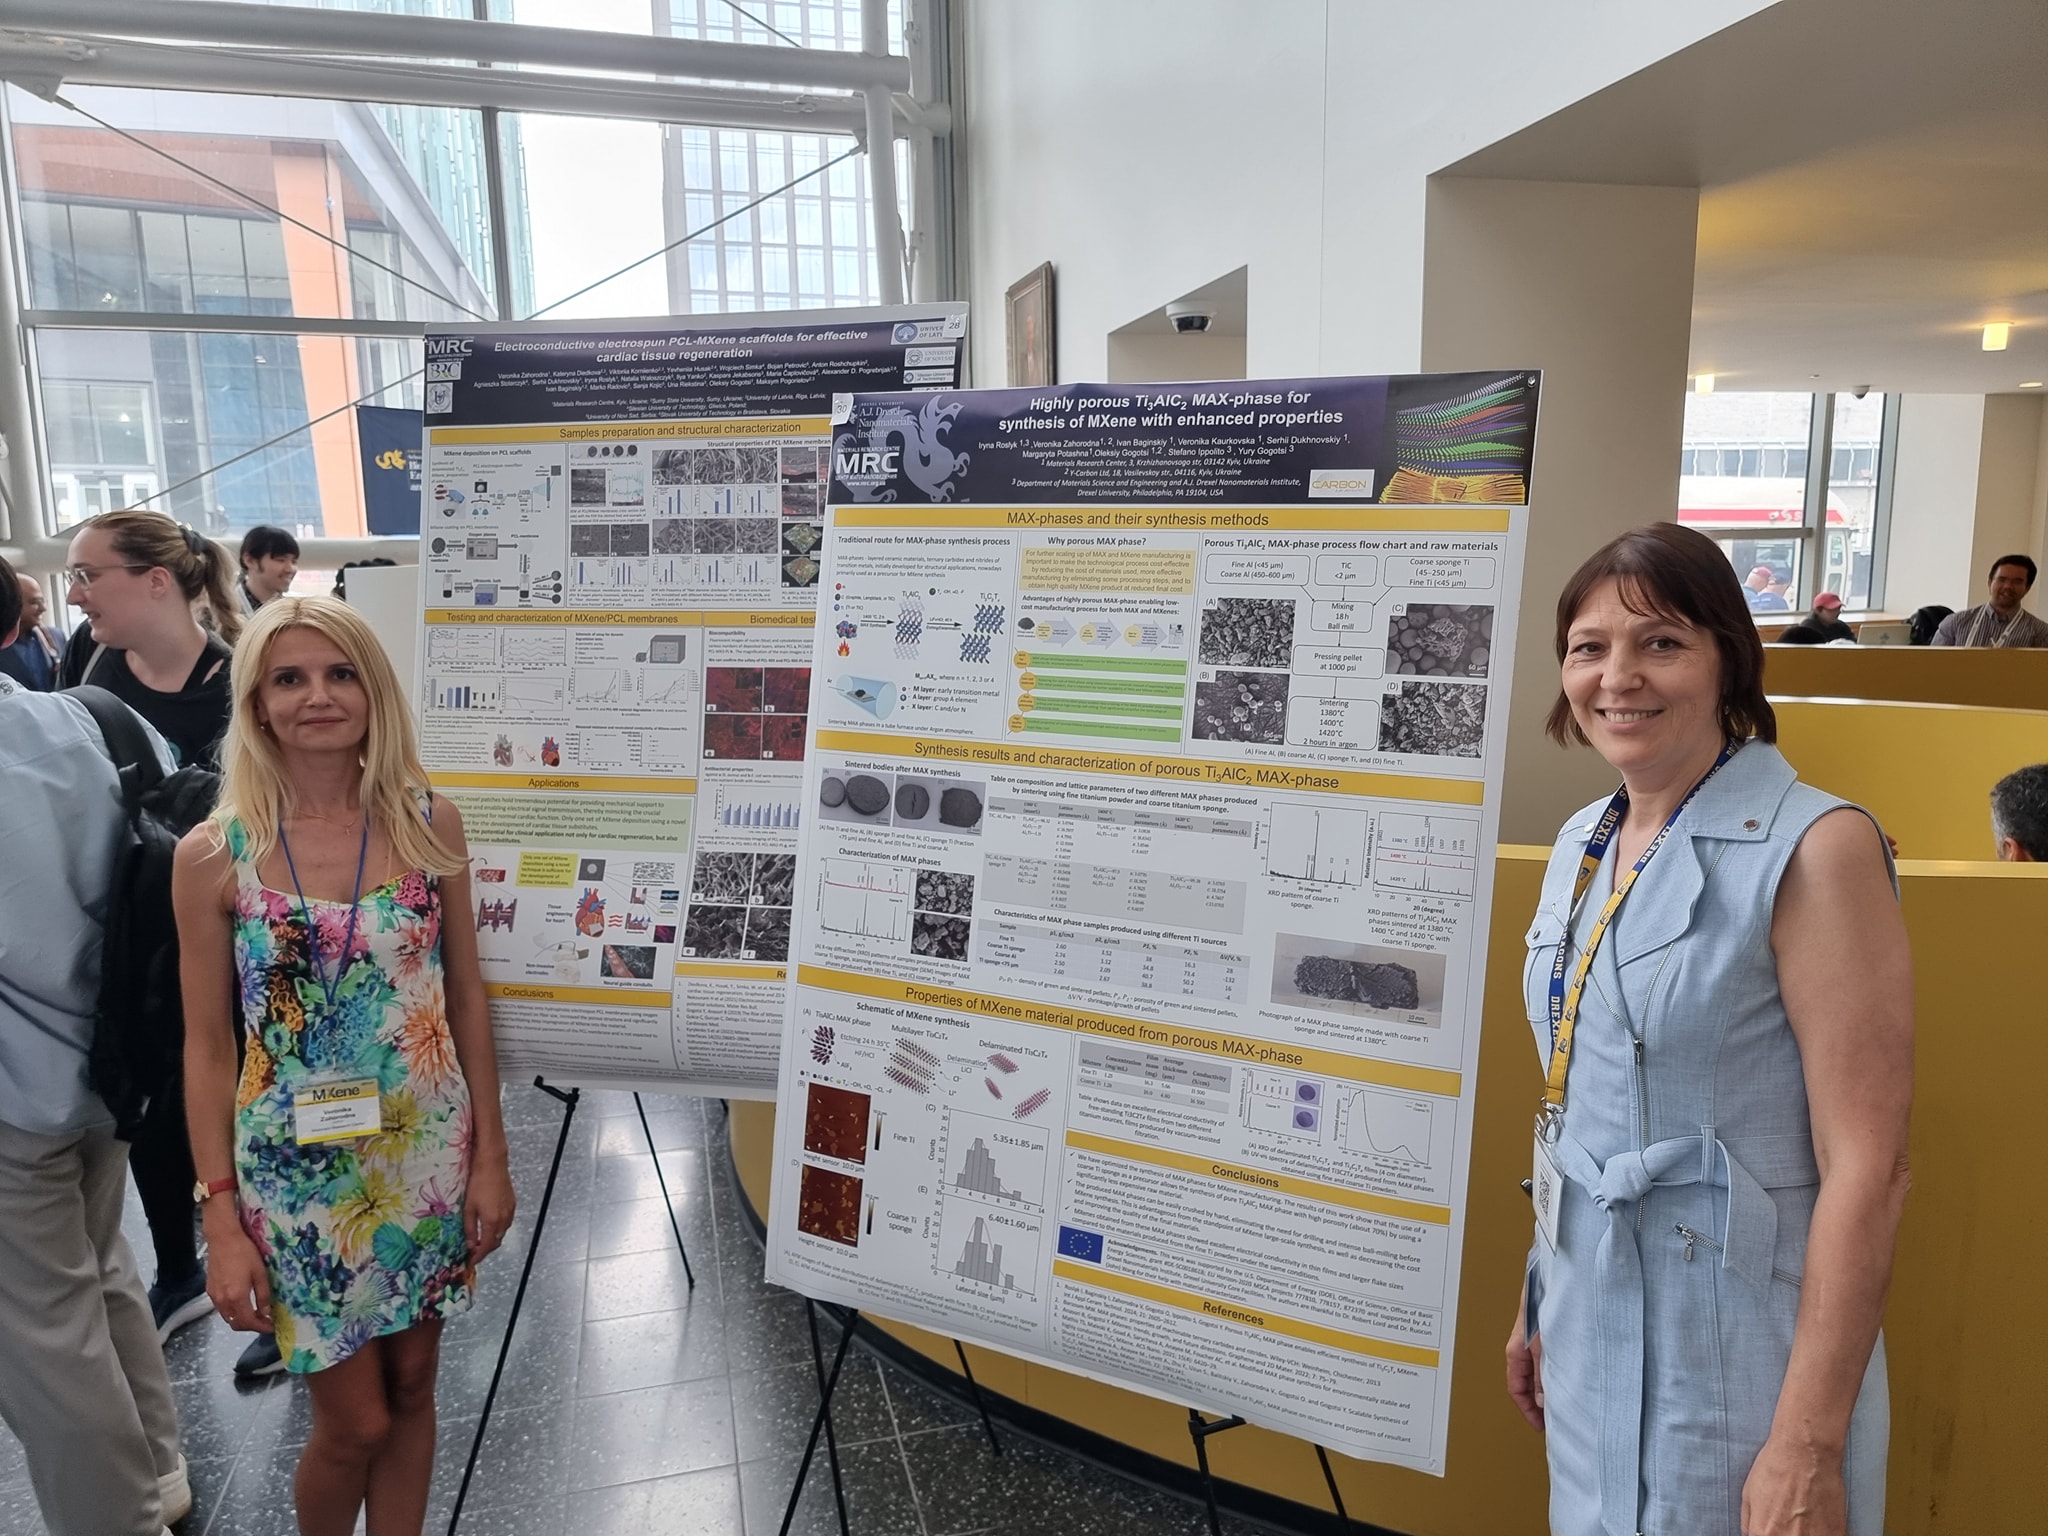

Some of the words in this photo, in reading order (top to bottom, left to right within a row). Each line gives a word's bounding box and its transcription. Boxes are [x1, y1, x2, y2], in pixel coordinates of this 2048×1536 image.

[428, 339, 474, 354] MRC
[494, 340, 595, 351] Electroconductive
[598, 339, 665, 348] electrospun
[668, 336, 736, 346] PCL-MXene
[739, 333, 793, 343] scaffolds
[796, 332, 814, 341] for
[816, 330, 867, 340] effective
[596, 350, 638, 362] cardiac
[641, 349, 676, 360] tissue
[679, 348, 753, 361] regeneration
[1030, 396, 1074, 412] Highly
[1078, 397, 1129, 411] porous
[1192, 392, 1282, 407] MAX-phase
[1287, 390, 1311, 403] for
[836, 405, 847, 413] 30
[998, 415, 1064, 432] synthesis
[1069, 414, 1084, 428] of
[1088, 414, 1136, 427] MXene
[1141, 409, 1172, 426] with
[1177, 408, 1254, 425] enhanced
[1258, 410, 1342, 426] properties
[560, 428, 599, 440] Samples
[602, 426, 654, 440] preparation
[657, 426, 674, 435] and
[677, 424, 720, 435] structural
[724, 423, 800, 434] characterization
[836, 452, 900, 474] MRC
[1017, 478, 1052, 487] Department
[1053, 479, 1060, 487] of
[1129, 479, 1168, 487] Engineering
[1168, 478, 1182, 486] and
[1182, 478, 1194, 486] A.J.
[1312, 480, 1366, 488] CARBON
[1132, 488, 1173, 496] Philadelphia,
[1175, 488, 1183, 496] PA
[1185, 488, 1207, 496] 19104,
[1209, 488, 1223, 496] USA
[1007, 512, 1083, 526] MAX-phases
[1087, 512, 1110, 524] and
[1114, 512, 1142, 524] their
[1145, 513, 1206, 527] synthesis
[1210, 513, 1268, 525] methods
[894, 535, 904, 543] for
[905, 536, 946, 545] MAX-phase
[948, 537, 981, 545] synthesis
[982, 538, 1010, 546] process
[1047, 536, 1065, 545] Why
[1096, 537, 1116, 545] MAX
[1117, 537, 1146, 546] phase?
[1204, 538, 1234, 547] Porous
[1268, 539, 1319, 549] MAX-phase
[1359, 540, 1380, 548] flow
[1382, 540, 1407, 549] chart
[1409, 541, 1428, 549] and
[1451, 541, 1498, 550] materials
[1331, 602, 1354, 611] Mixing
[447, 613, 475, 623] Testing
[478, 613, 493, 621] and
[496, 613, 561, 622] characterization
[564, 613, 572, 622] of
[575, 614, 625, 622] MXene/PCL
[628, 614, 678, 623] membranes
[750, 615, 797, 624] Biomedical
[1314, 652, 1341, 661] Pressing
[1346, 664, 1356, 672] psi
[1320, 699, 1348, 708] Sintering
[844, 760, 871, 773] Sintered
[872, 762, 894, 775] bodies
[895, 765, 911, 776] after
[912, 766, 928, 778] MAX
[930, 769, 960, 780] synthesis
[914, 742, 968, 757] Synthesis
[972, 747, 1010, 760] results
[1014, 751, 1035, 763] and
[1040, 752, 1136, 771] characterization
[1140, 760, 1153, 772] of
[1156, 763, 1200, 777] porous
[1256, 770, 1339, 788] MAX-phase
[528, 778, 579, 788] Applications
[1592, 808, 1619, 845] DREXEL
[838, 847, 890, 860] Characterization
[900, 854, 916, 862] MAX
[917, 857, 940, 865] phases
[503, 987, 553, 998] Conclusions
[856, 1002, 894, 1015] Schematic
[896, 1008, 904, 1016] of
[905, 1010, 932, 1021] MXene
[934, 1016, 969, 1028] synthesis
[906, 987, 962, 1007] Properties
[966, 999, 978, 1009] of
[980, 1000, 1021, 1017] MXene
[1026, 1008, 1073, 1025] material
[1077, 1019, 1134, 1036] produced
[1140, 1026, 1168, 1041] from
[1172, 1033, 1217, 1050] porous
[1222, 1040, 1303, 1065] MAX-phase
[313, 1086, 360, 1101] MXene
[1212, 1164, 1278, 1187] Conclusions
[1203, 1301, 1263, 1325] References
